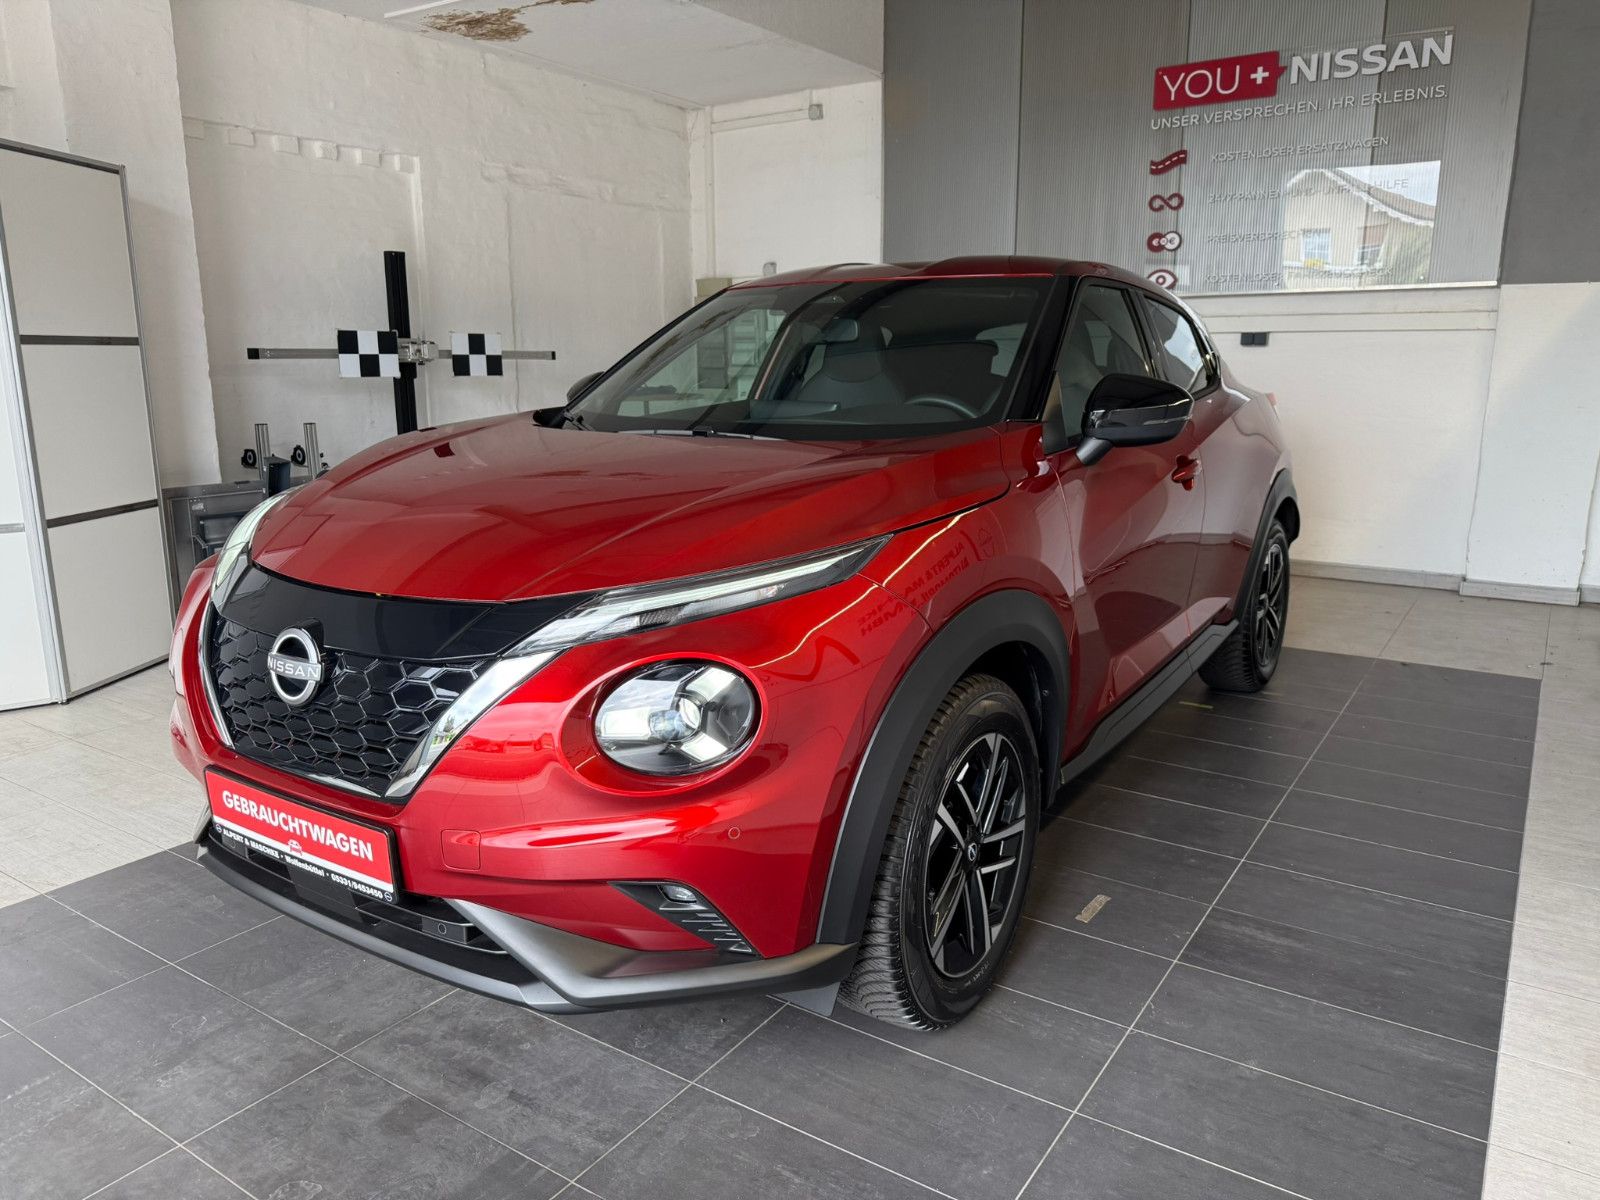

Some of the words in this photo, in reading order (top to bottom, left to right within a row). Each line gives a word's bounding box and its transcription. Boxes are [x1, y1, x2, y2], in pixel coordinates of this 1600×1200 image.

[1162, 65, 1240, 101] YOU
[1289, 34, 1453, 85] NISSAN
[1151, 113, 1200, 130] UNSER
[1203, 99, 1323, 125] VERSPRECHEN.
[1327, 94, 1355, 110] IHR
[1360, 84, 1448, 107] ERLEBNIS.
[1211, 144, 1295, 163] KOSTENLOSER
[1298, 136, 1391, 155] ERSATZWAGEN
[267, 655, 319, 678] NISSAN
[222, 790, 374, 862] GEBRAUCHTWAGEN
